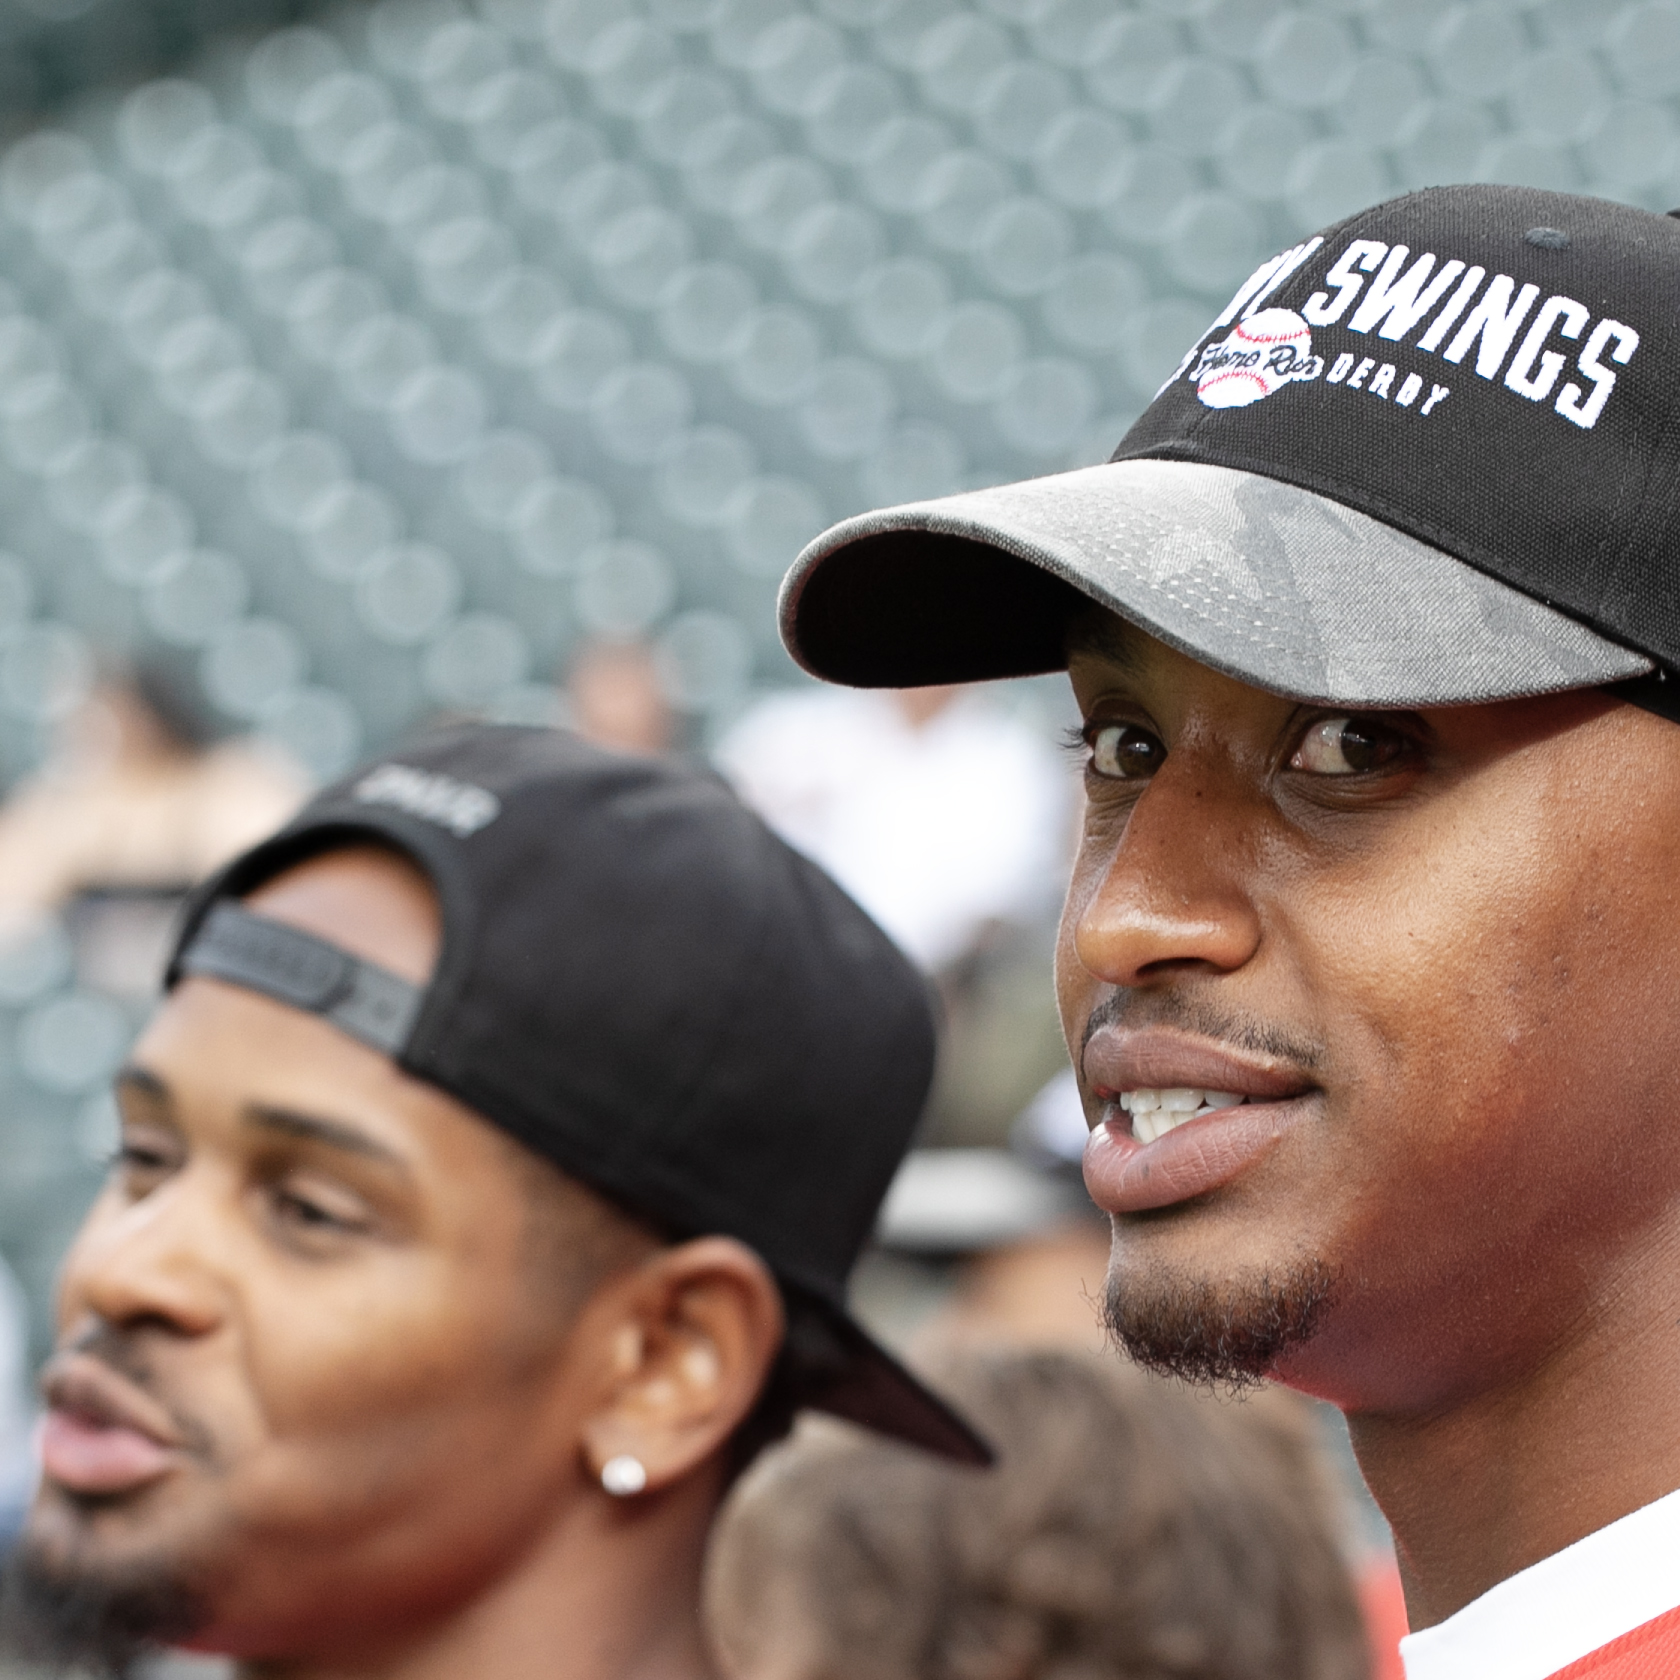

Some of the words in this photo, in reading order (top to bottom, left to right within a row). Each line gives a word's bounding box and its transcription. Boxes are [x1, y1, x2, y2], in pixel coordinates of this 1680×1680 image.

[1263, 344, 1318, 376] Run
[1306, 239, 1640, 430] SWINGS
[1326, 352, 1451, 416] DERBY
